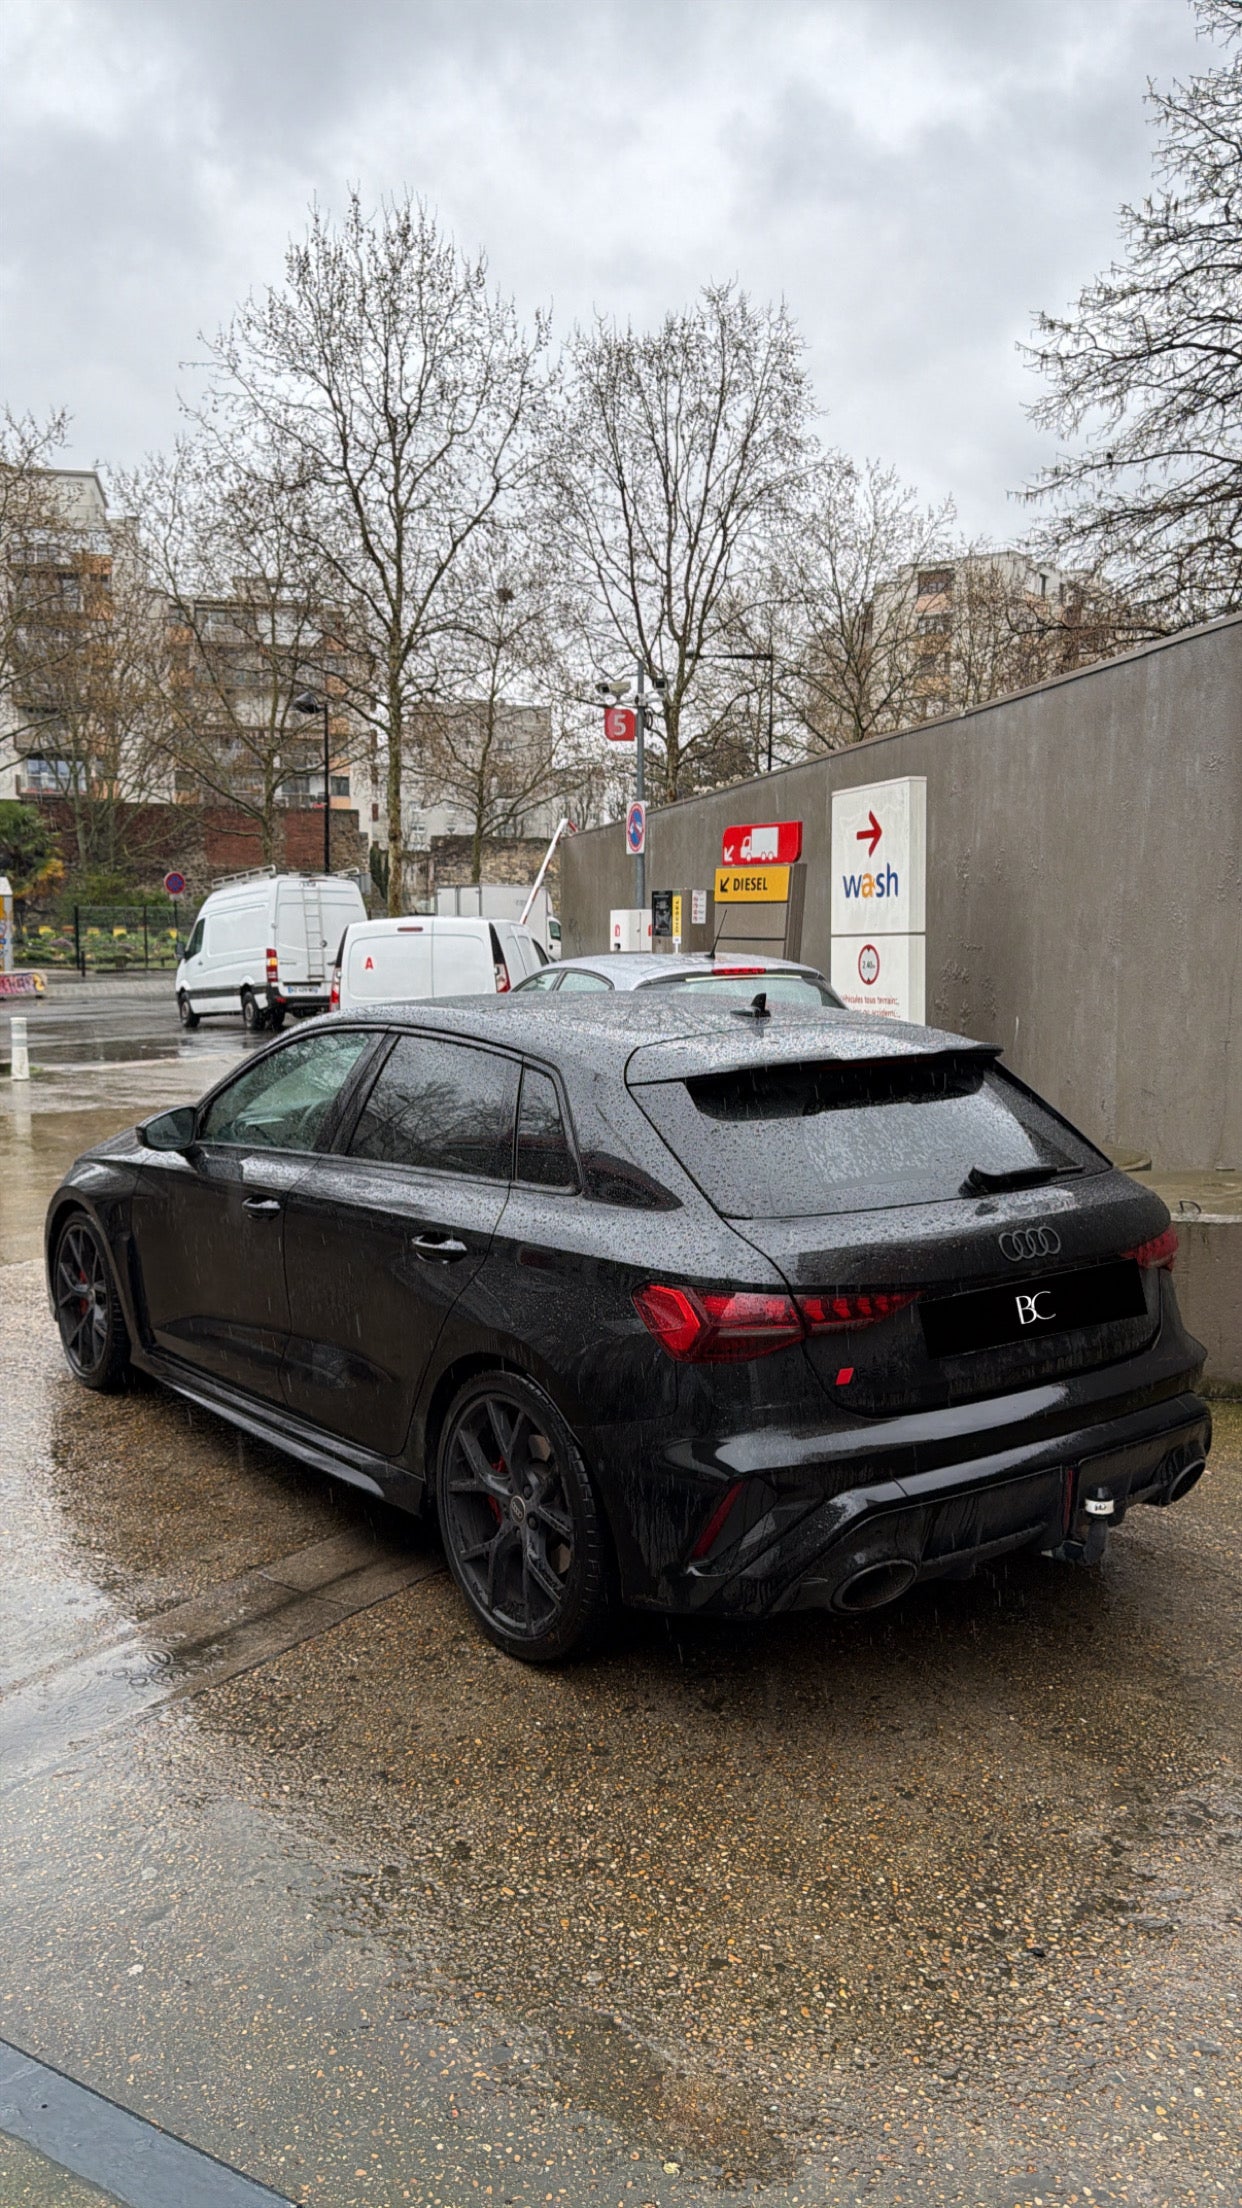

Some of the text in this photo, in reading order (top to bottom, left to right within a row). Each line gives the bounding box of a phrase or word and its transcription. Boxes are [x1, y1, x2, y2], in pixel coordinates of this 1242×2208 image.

[614, 714, 627, 736] 5
[733, 877, 768, 891] DIESEL
[842, 862, 899, 898] wash
[365, 956, 374, 970] A
